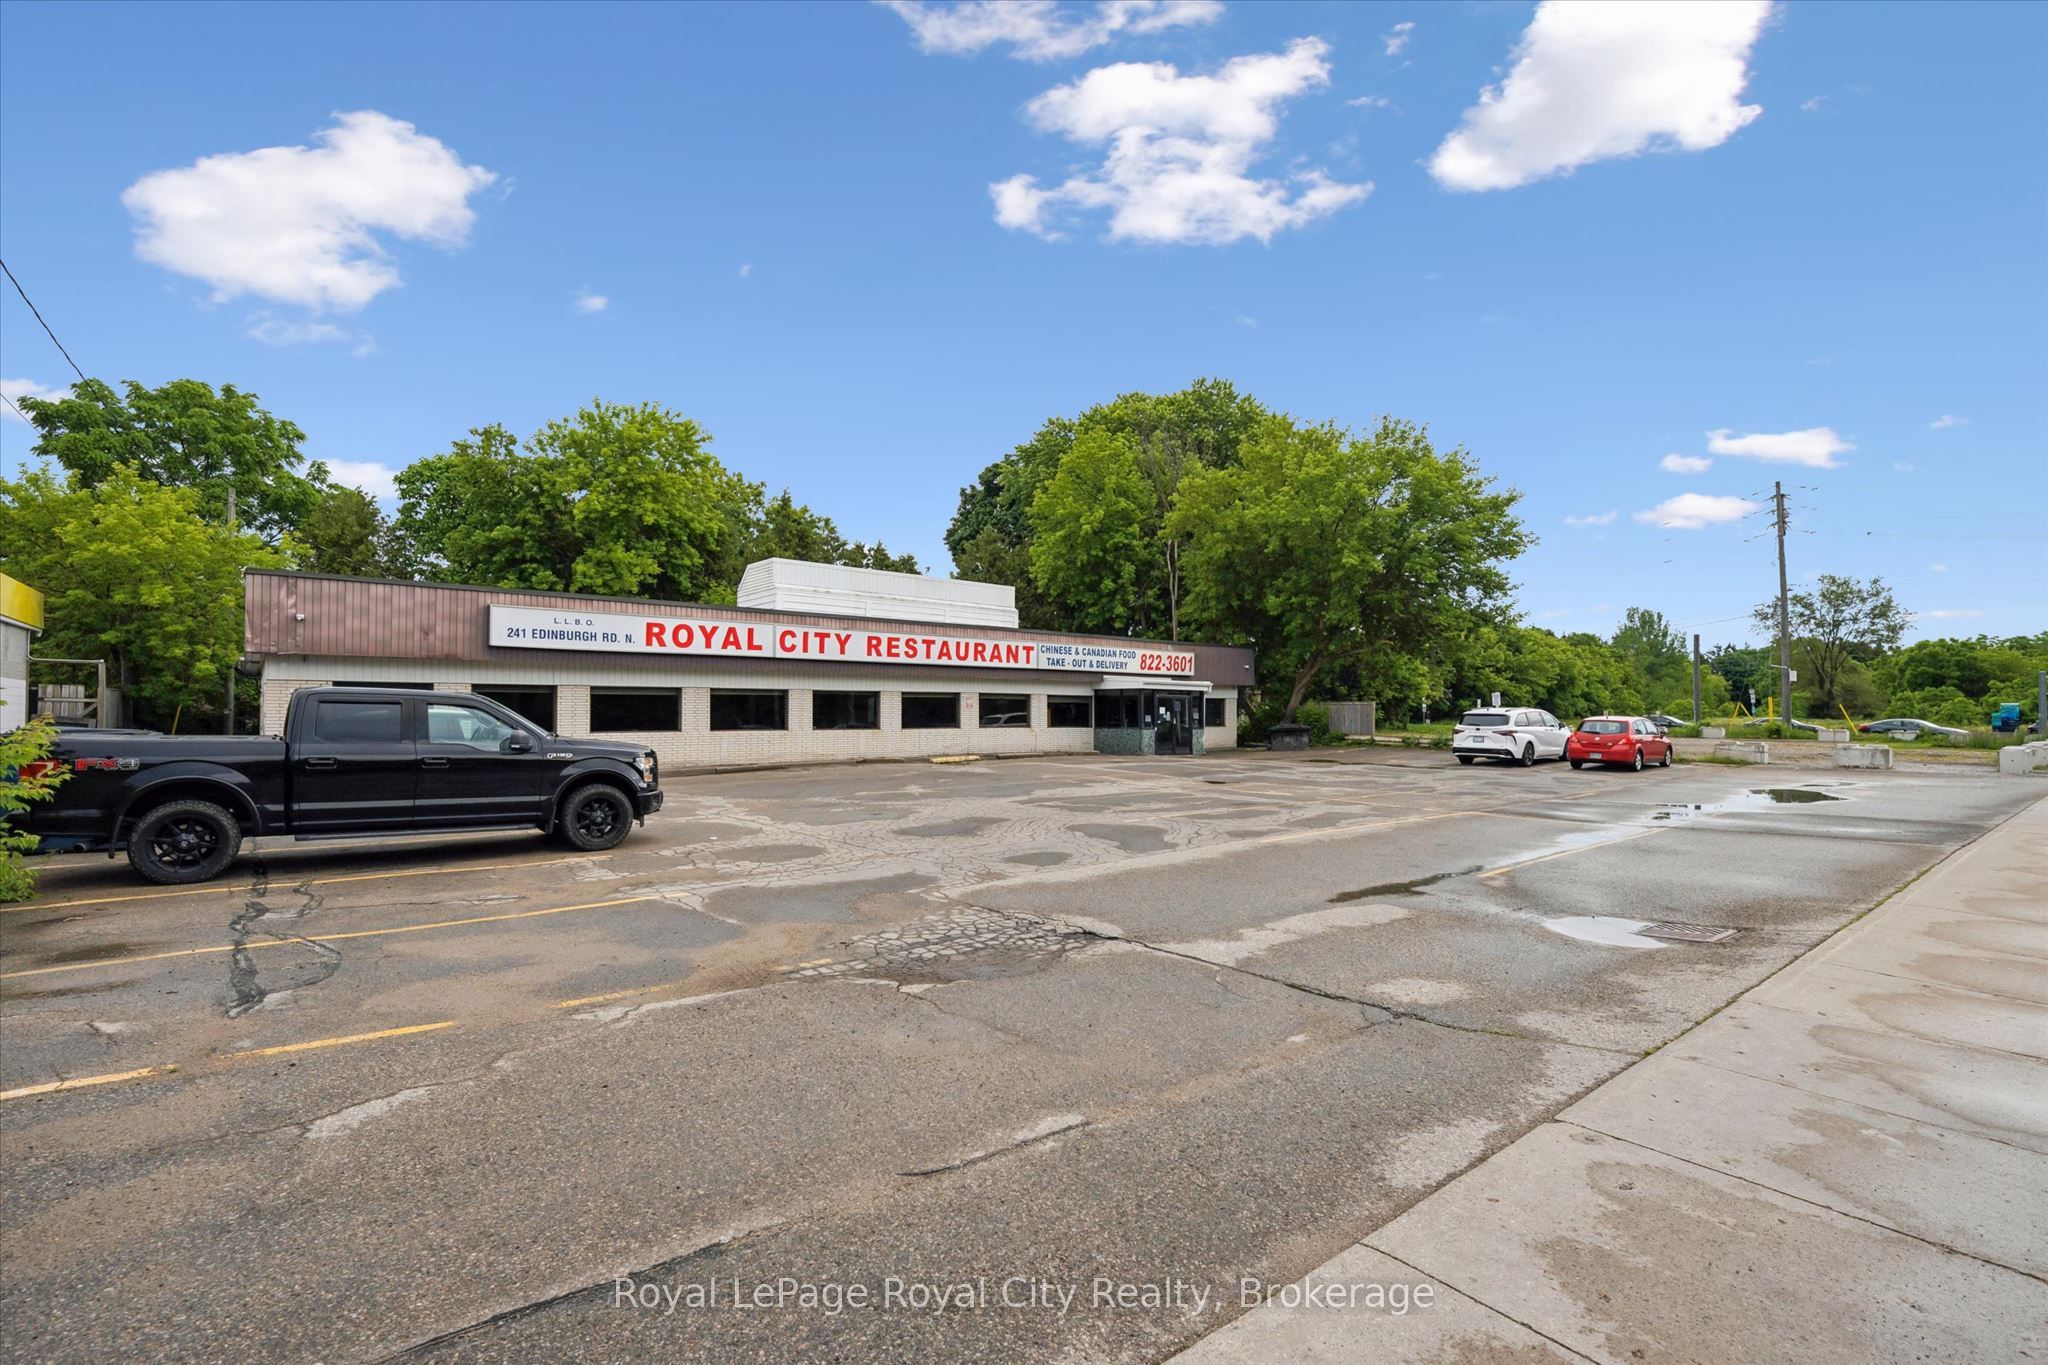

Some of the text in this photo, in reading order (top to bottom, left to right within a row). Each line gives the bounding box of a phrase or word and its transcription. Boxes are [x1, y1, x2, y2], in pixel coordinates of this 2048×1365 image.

[507, 627, 636, 644] 241 EDINBURGH RD. N.
[645, 622, 1034, 665] ROYAL CITY RESTAURANT
[1040, 645, 1072, 655] CHINESE
[1082, 647, 1117, 658] CANADIAN
[1119, 650, 1136, 659] FOOD
[1046, 657, 1066, 667] TAKE
[1072, 658, 1086, 668] OUT
[1089, 660, 1094, 669] &
[1096, 660, 1128, 670] DELIVERY
[1139, 653, 1193, 673] 822-3601
